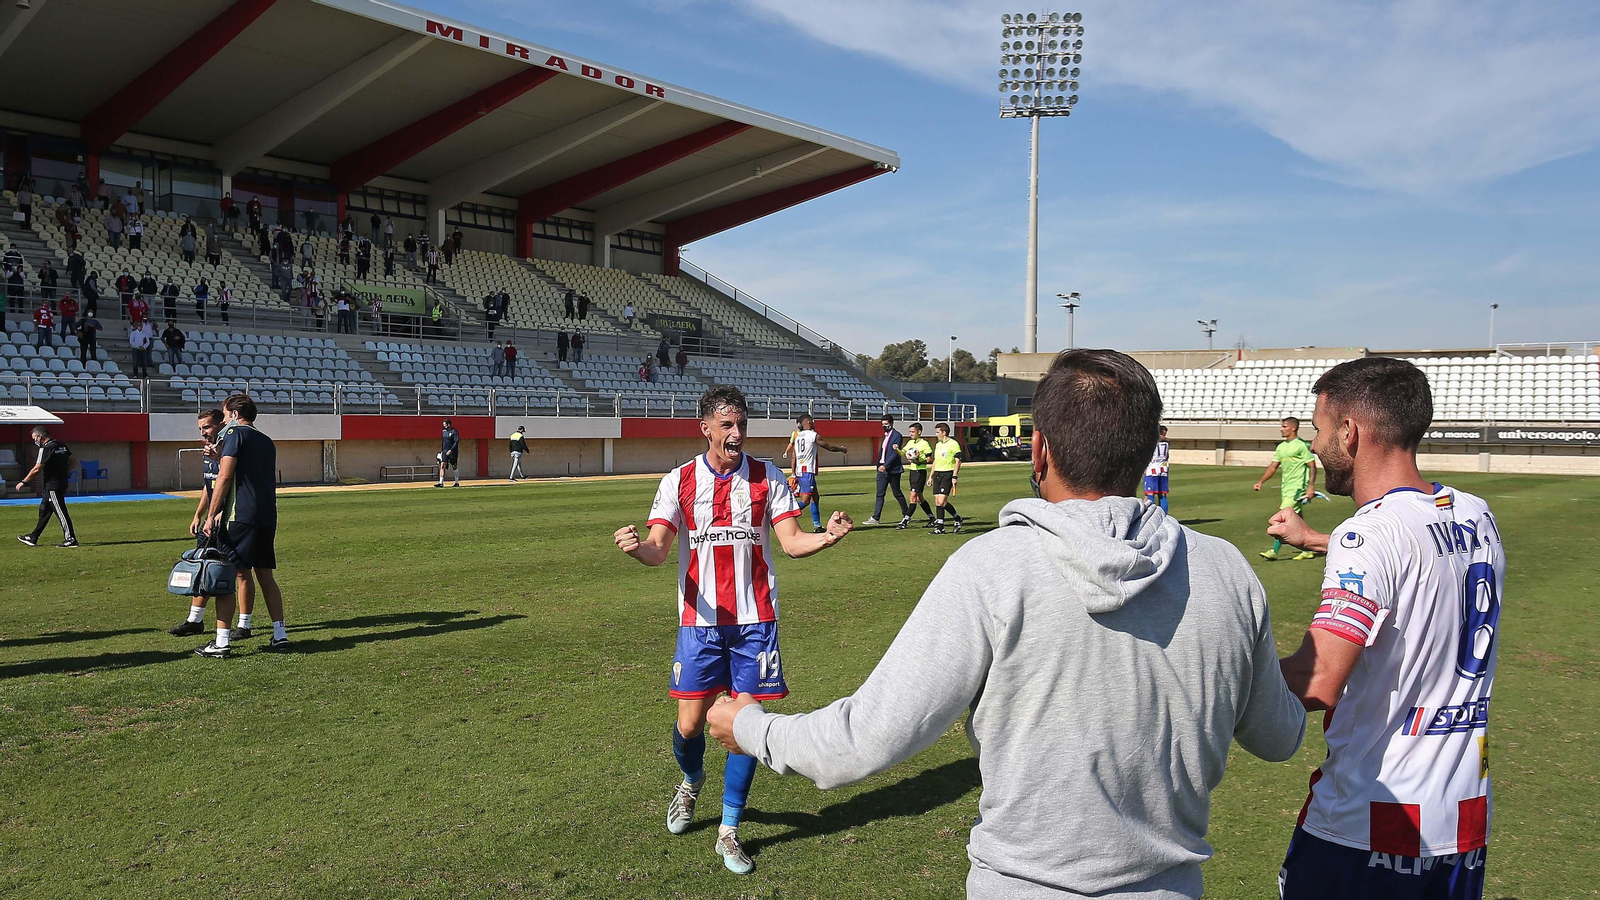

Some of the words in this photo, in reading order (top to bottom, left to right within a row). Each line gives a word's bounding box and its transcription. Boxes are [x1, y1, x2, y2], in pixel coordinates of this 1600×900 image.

[426, 20, 666, 98] MIRADOR
[797, 437, 806, 454] 18
[1430, 431, 1443, 439] de
[1156, 443, 1168, 458] 17
[1455, 561, 1500, 681] 8
[755, 650, 780, 680] 19
